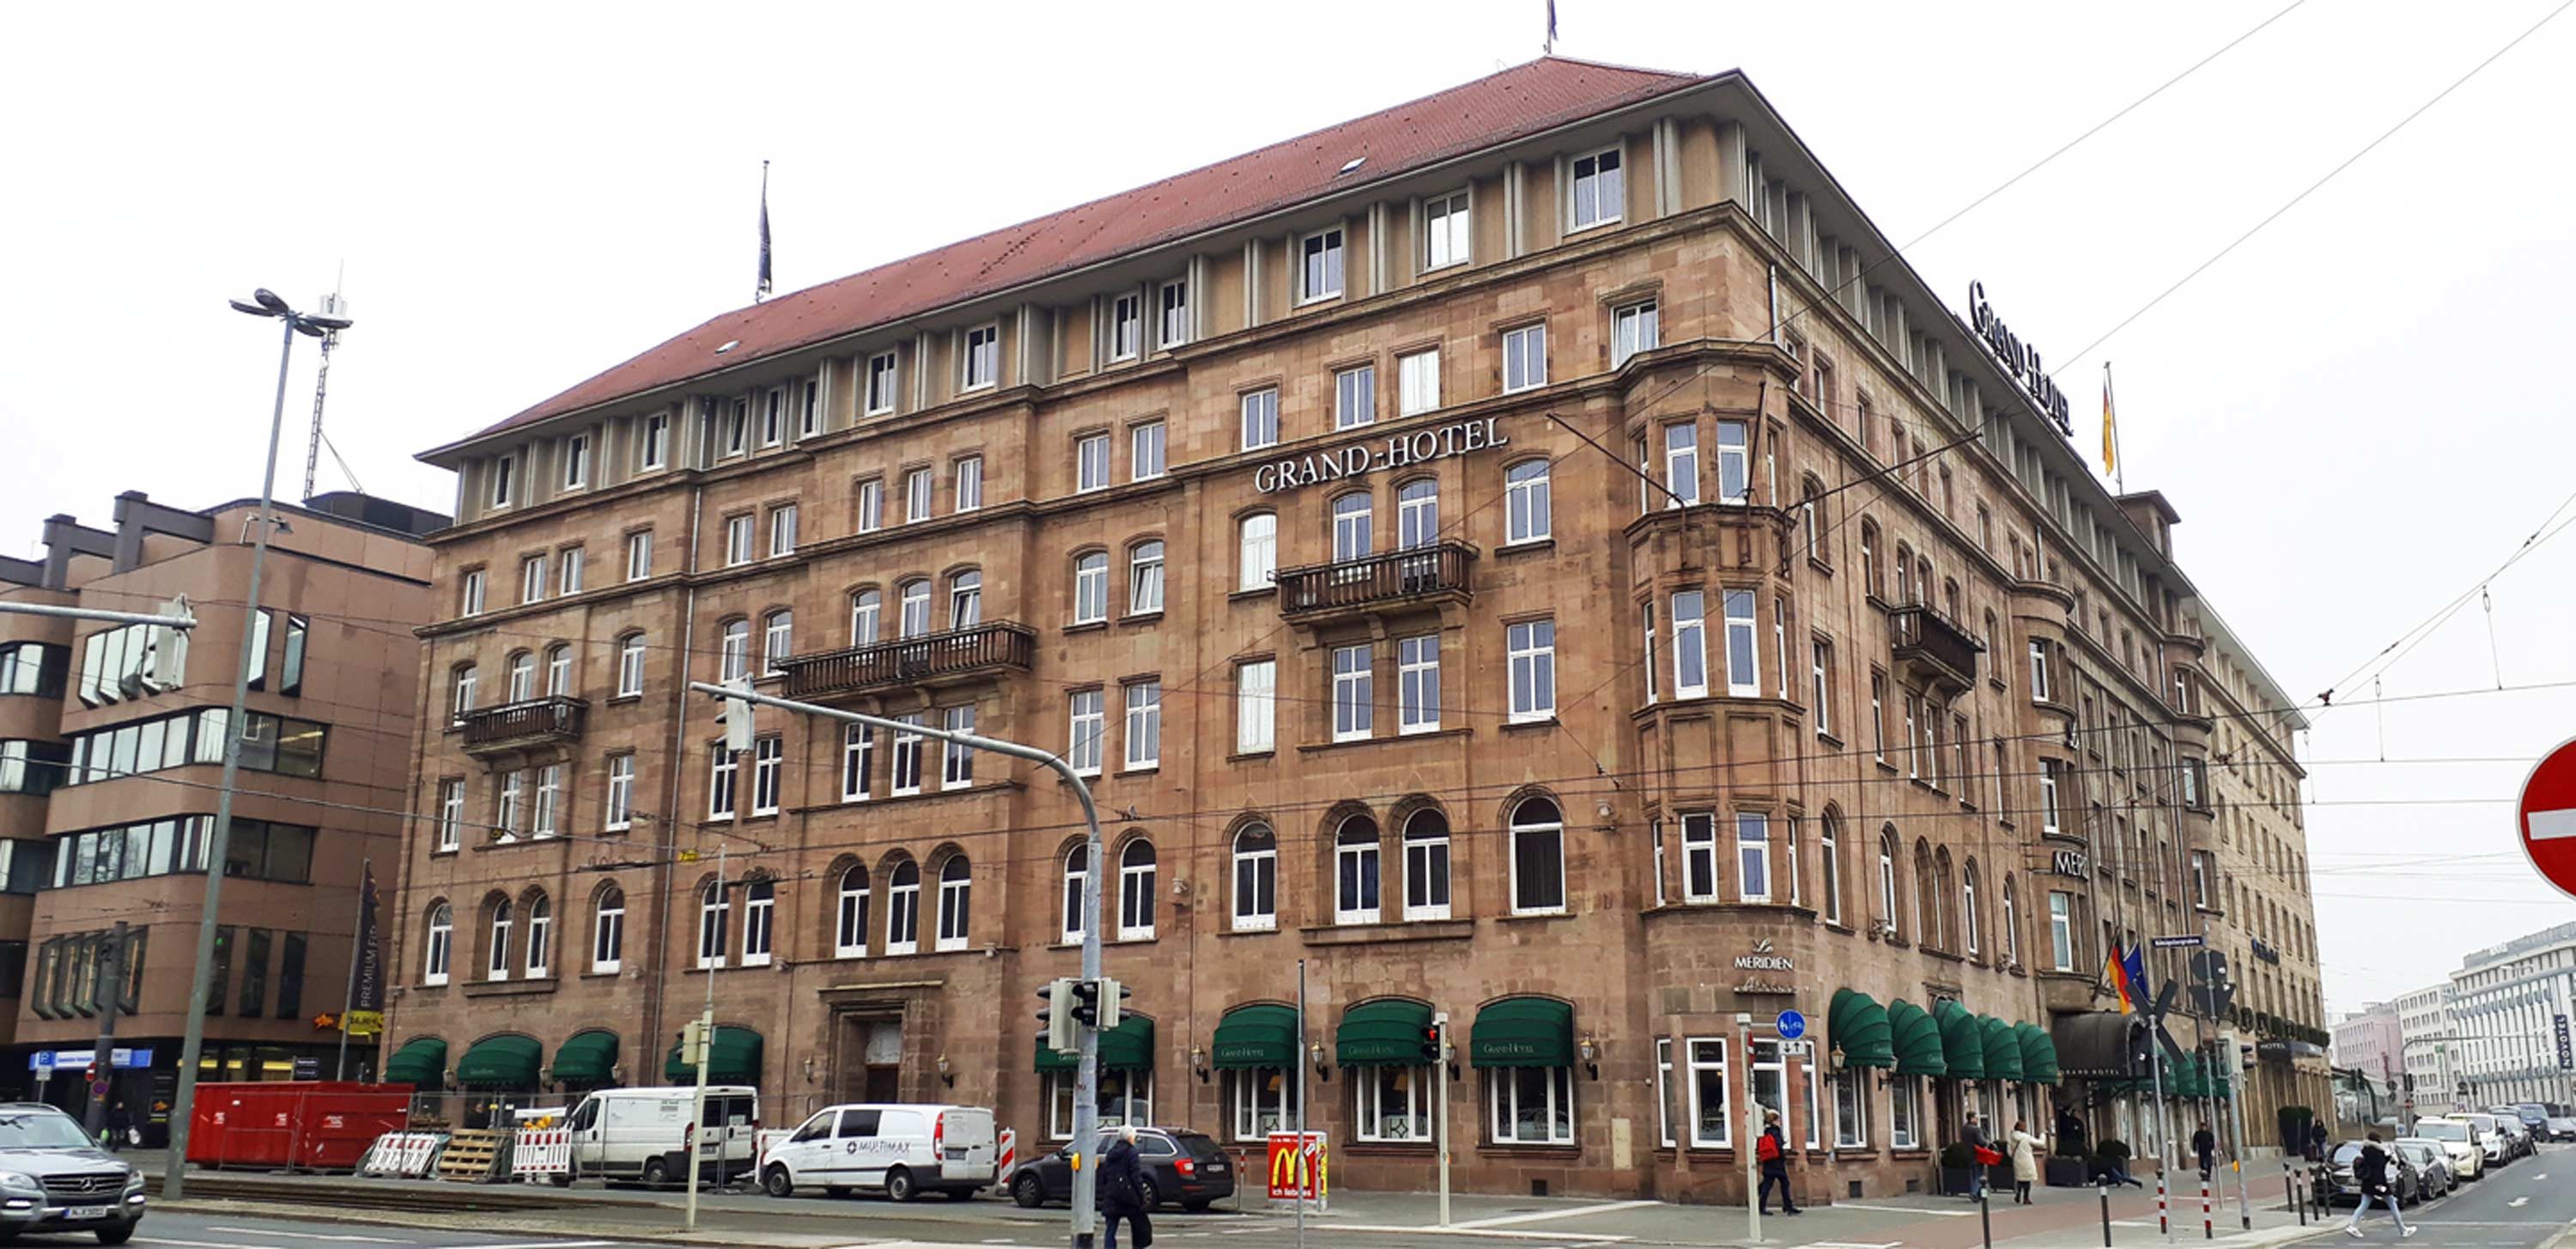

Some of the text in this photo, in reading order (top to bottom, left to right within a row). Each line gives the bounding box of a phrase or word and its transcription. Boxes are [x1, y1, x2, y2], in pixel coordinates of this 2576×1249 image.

[1734, 955, 1794, 970] MERIDIEN
[2557, 1016, 2571, 1067] NOVOTEL
[859, 1140, 911, 1154] MULTIMAX
